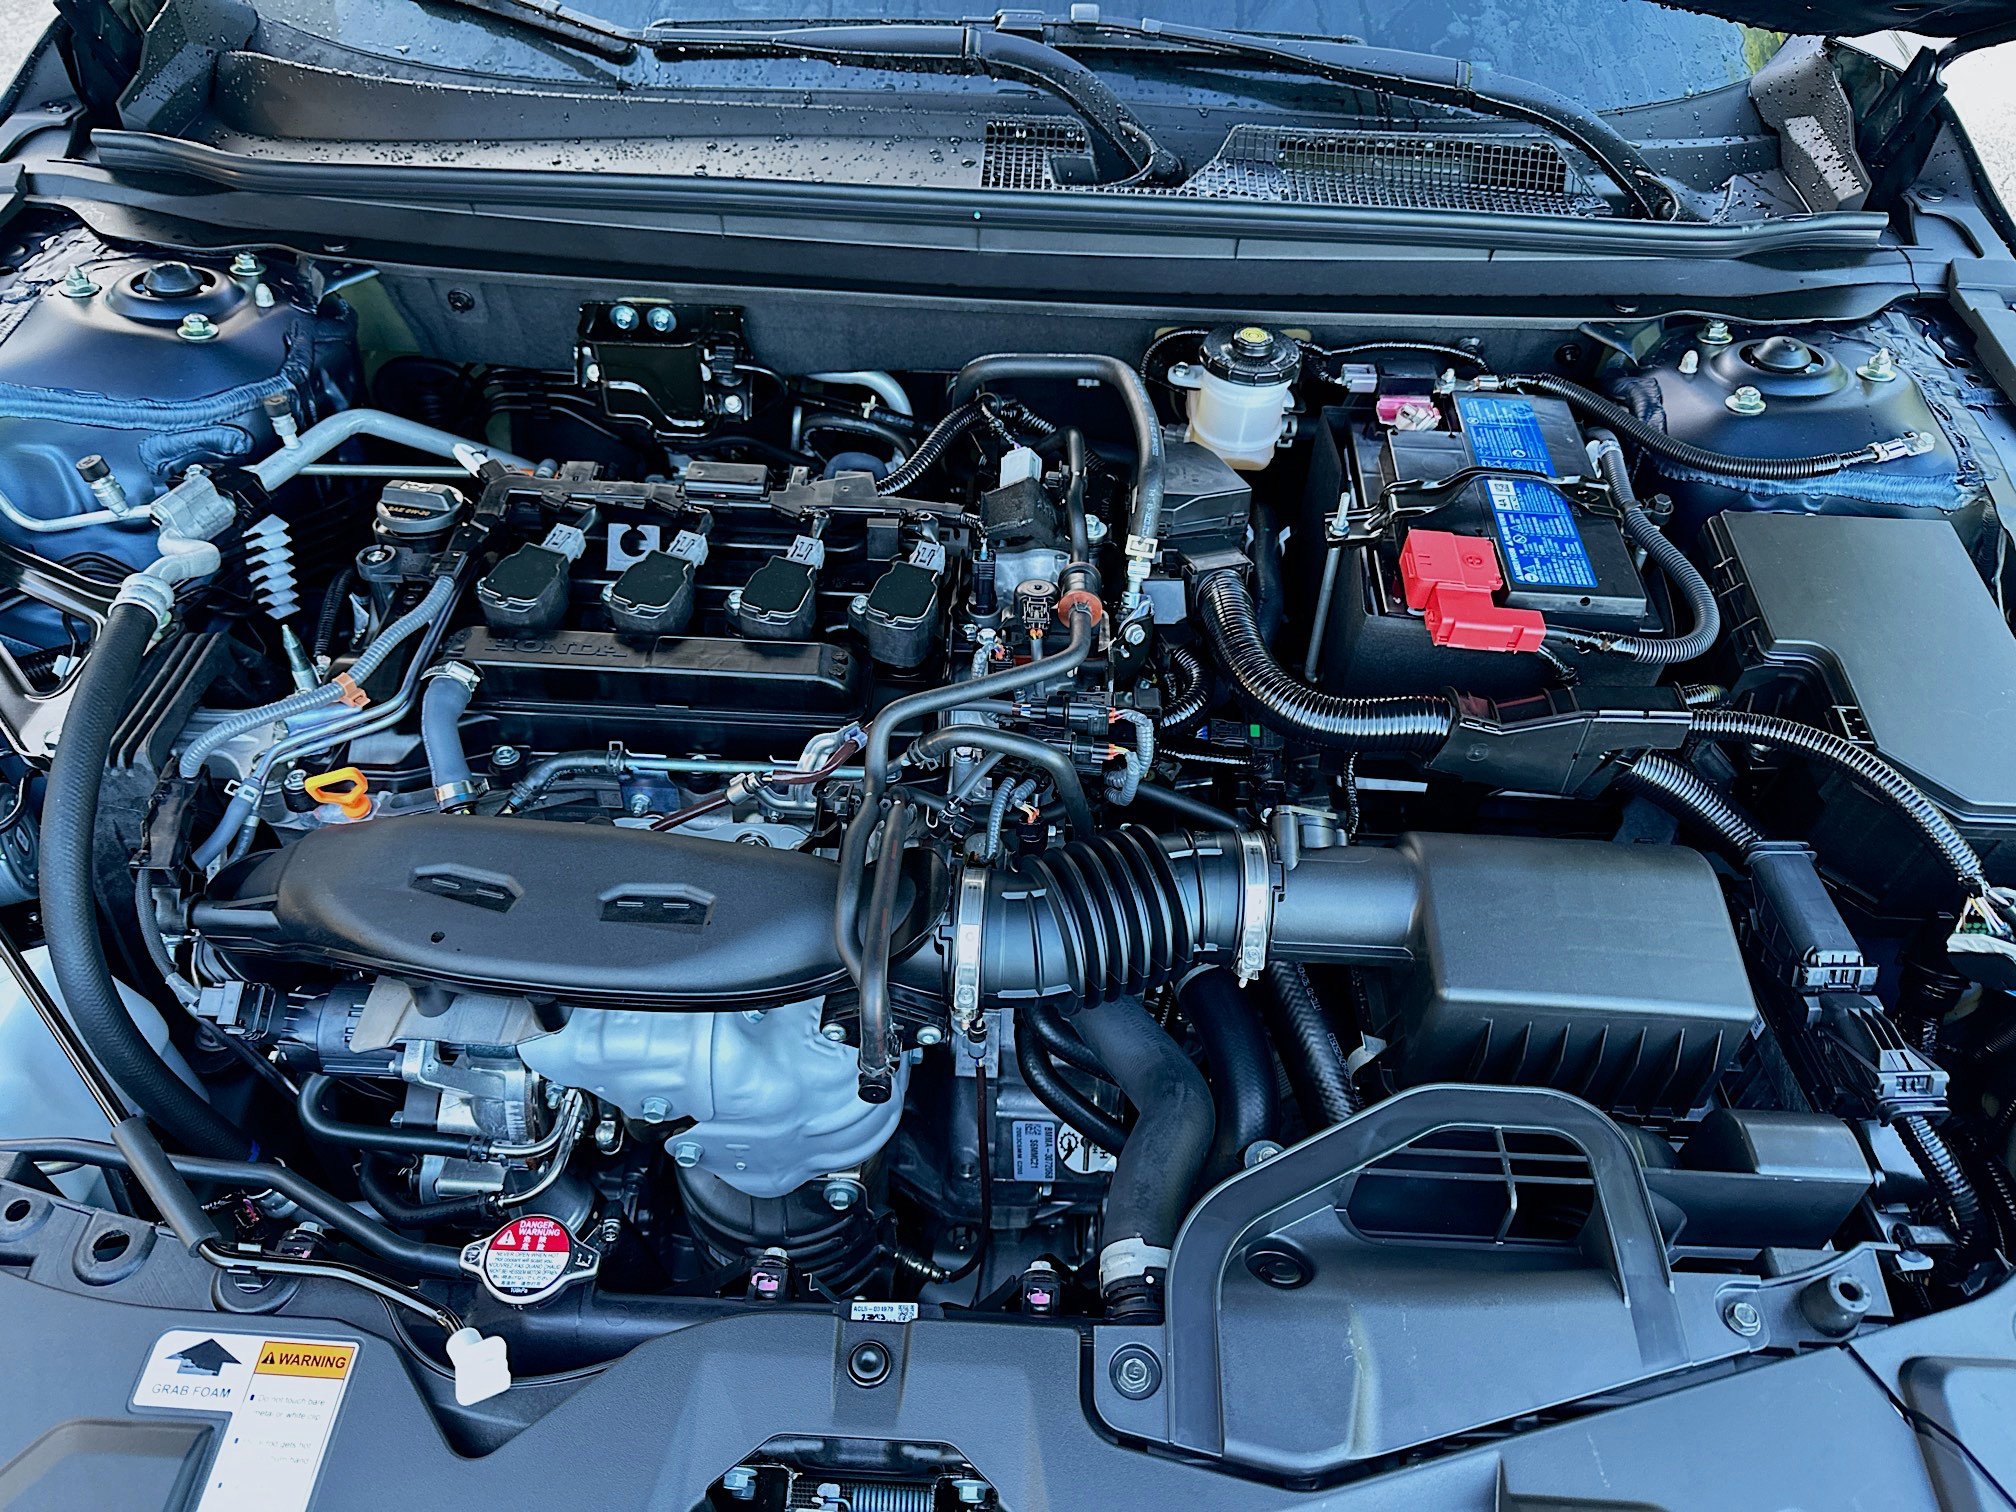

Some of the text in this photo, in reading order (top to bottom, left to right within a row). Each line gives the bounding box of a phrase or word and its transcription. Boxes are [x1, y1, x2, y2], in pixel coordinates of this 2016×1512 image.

[484, 638, 628, 658] HONDA
[519, 1228, 560, 1236] WARNUNG
[520, 1220, 554, 1229] DANGER
[279, 1352, 347, 1369] WARNING
[152, 1383, 232, 1398] GRAB FOAM
